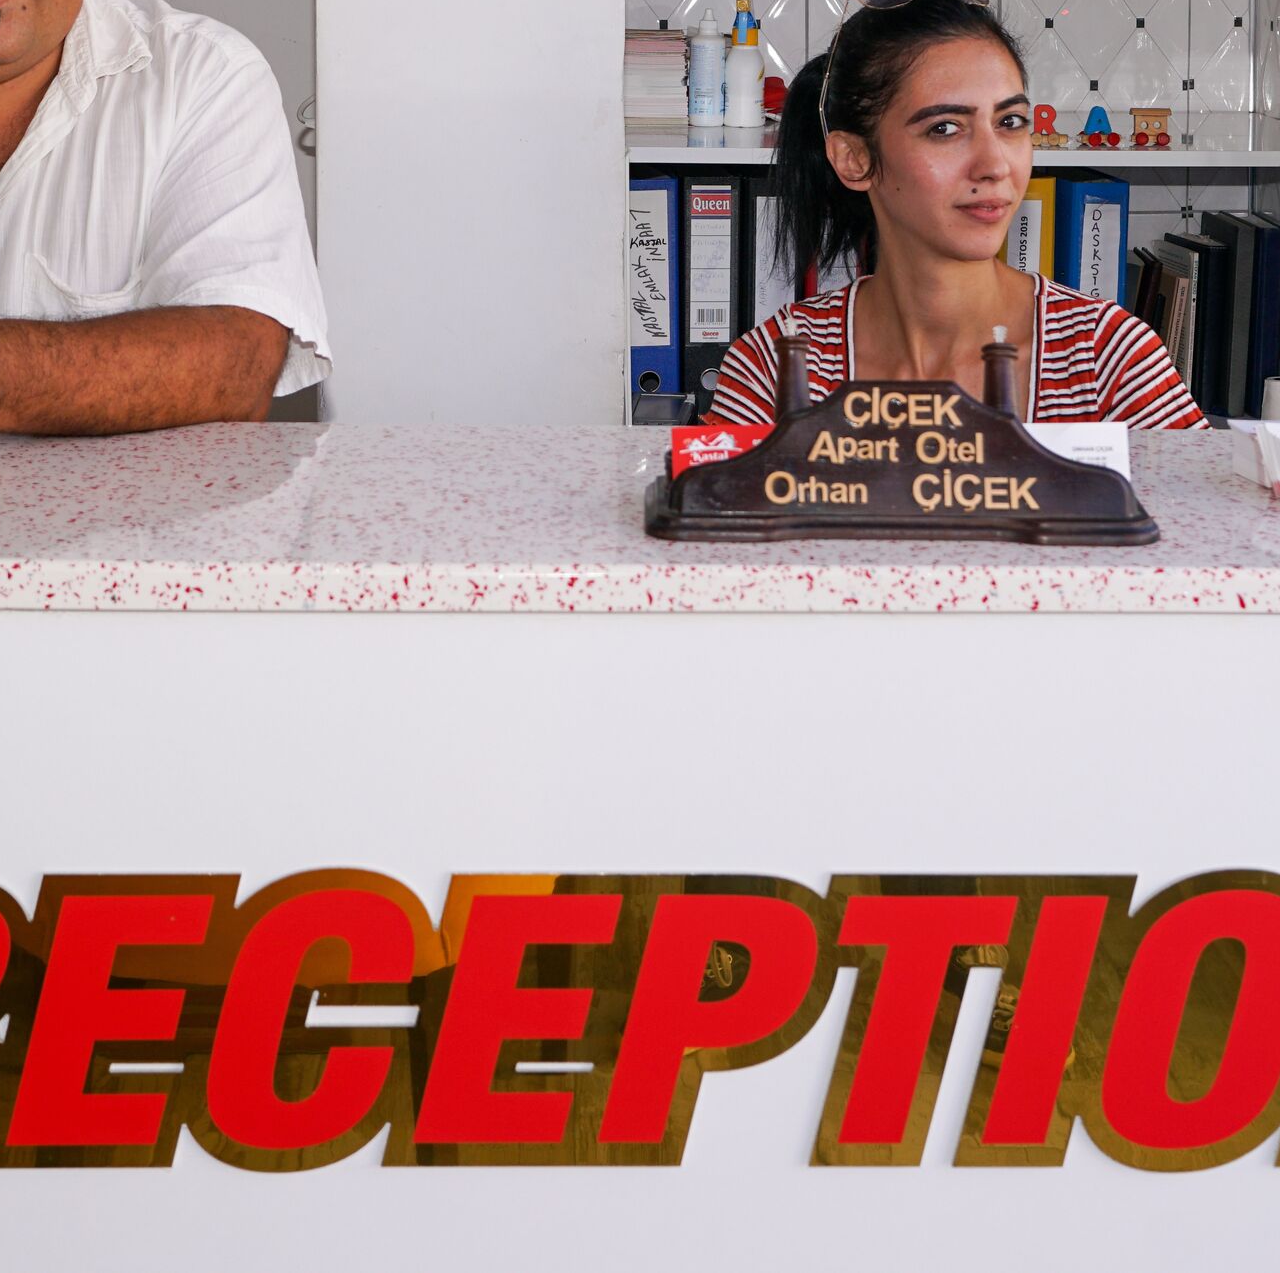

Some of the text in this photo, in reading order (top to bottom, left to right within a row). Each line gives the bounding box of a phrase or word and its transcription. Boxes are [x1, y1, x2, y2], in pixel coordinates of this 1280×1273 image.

[692, 196, 731, 213] Queen
[1019, 216, 1028, 238] 2019
[631, 255, 666, 302] EMLAK
[631, 290, 668, 339] KASTAL
[807, 431, 985, 465] Apart Otel
[764, 469, 1040, 512] Orhan ÇİÇEK
